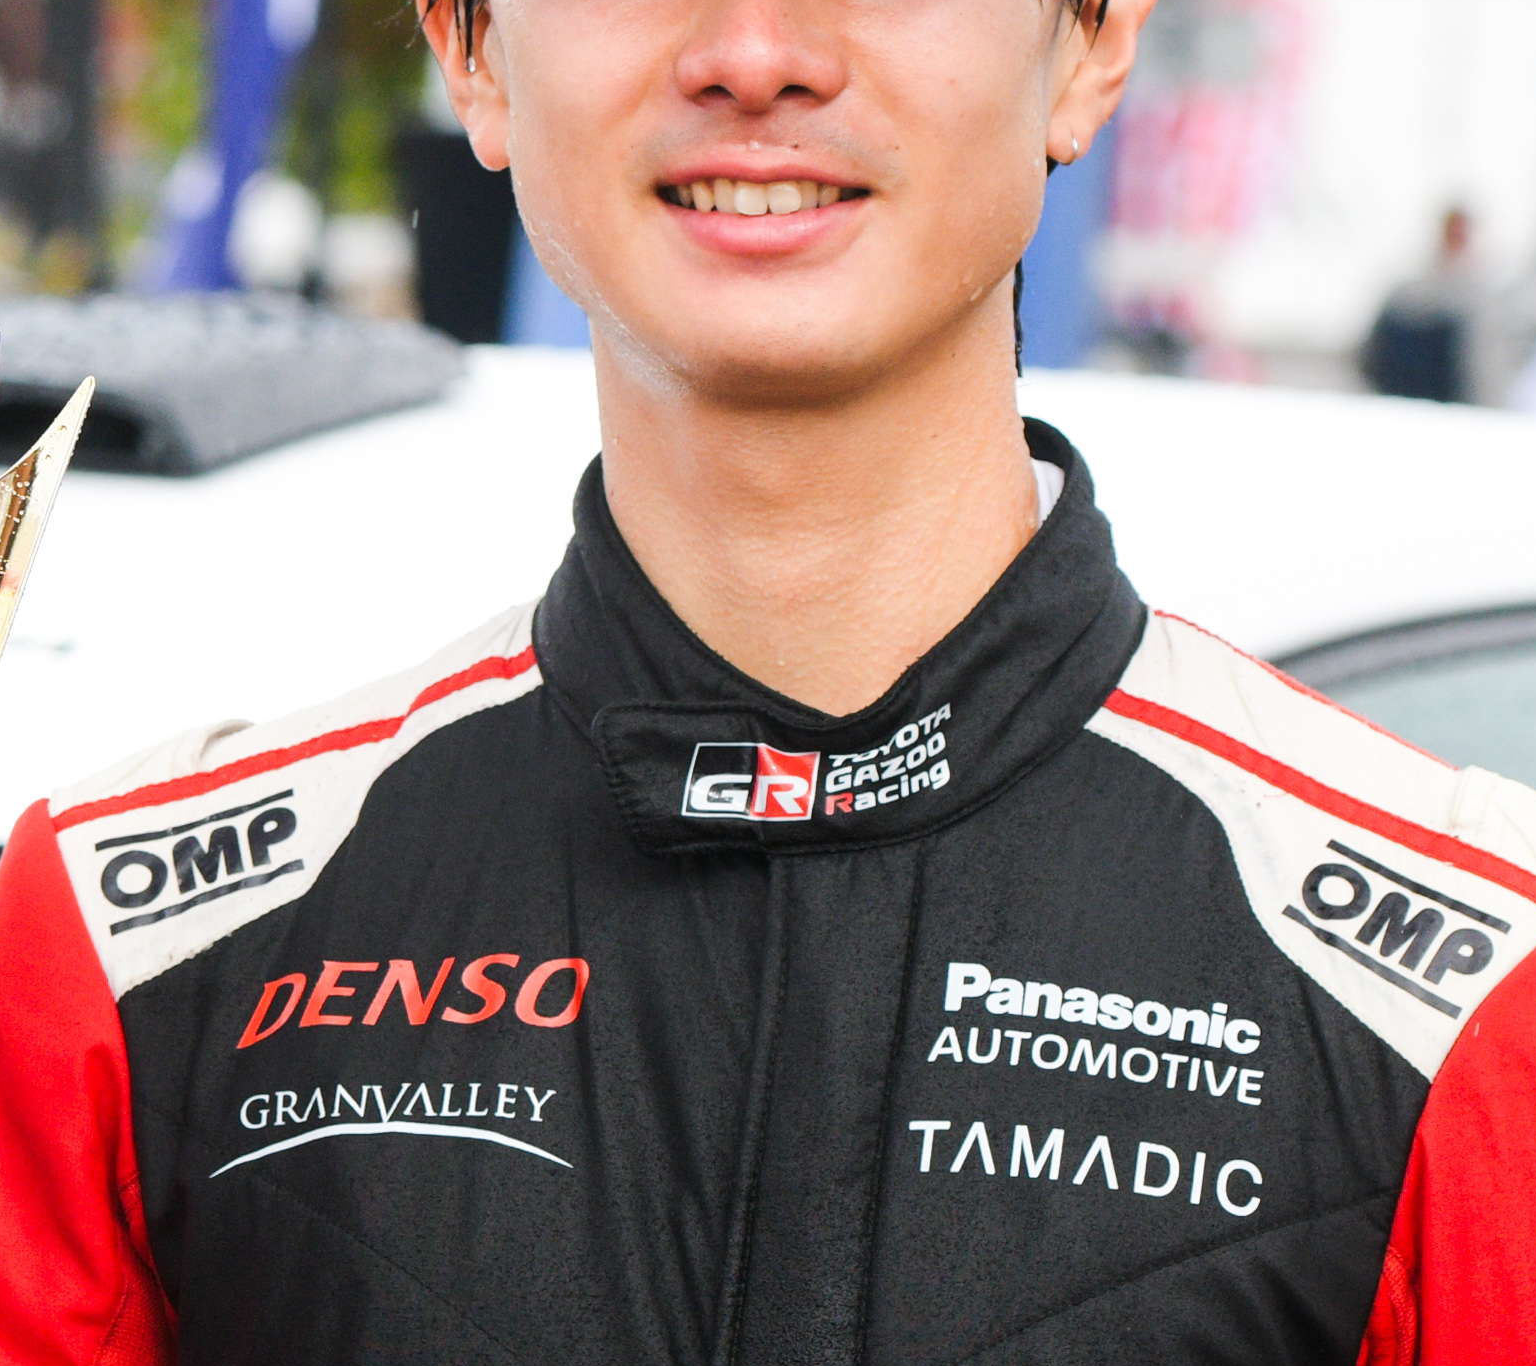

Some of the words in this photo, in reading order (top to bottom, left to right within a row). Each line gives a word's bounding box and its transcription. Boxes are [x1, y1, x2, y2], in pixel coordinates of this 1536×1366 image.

[825, 731, 947, 793] GAZOO
[827, 702, 952, 769] TOYOTA
[689, 773, 811, 816] GR
[825, 758, 951, 816] Racing
[100, 806, 297, 909] OMP
[1301, 862, 1495, 986] OMP
[236, 953, 591, 1050] DENSO
[943, 962, 1262, 1055] Panasonic
[239, 1082, 557, 1129] GRANVALLEY
[927, 1025, 1265, 1106] AUTOMOTIVE
[908, 1119, 1264, 1218] TAMADIC
